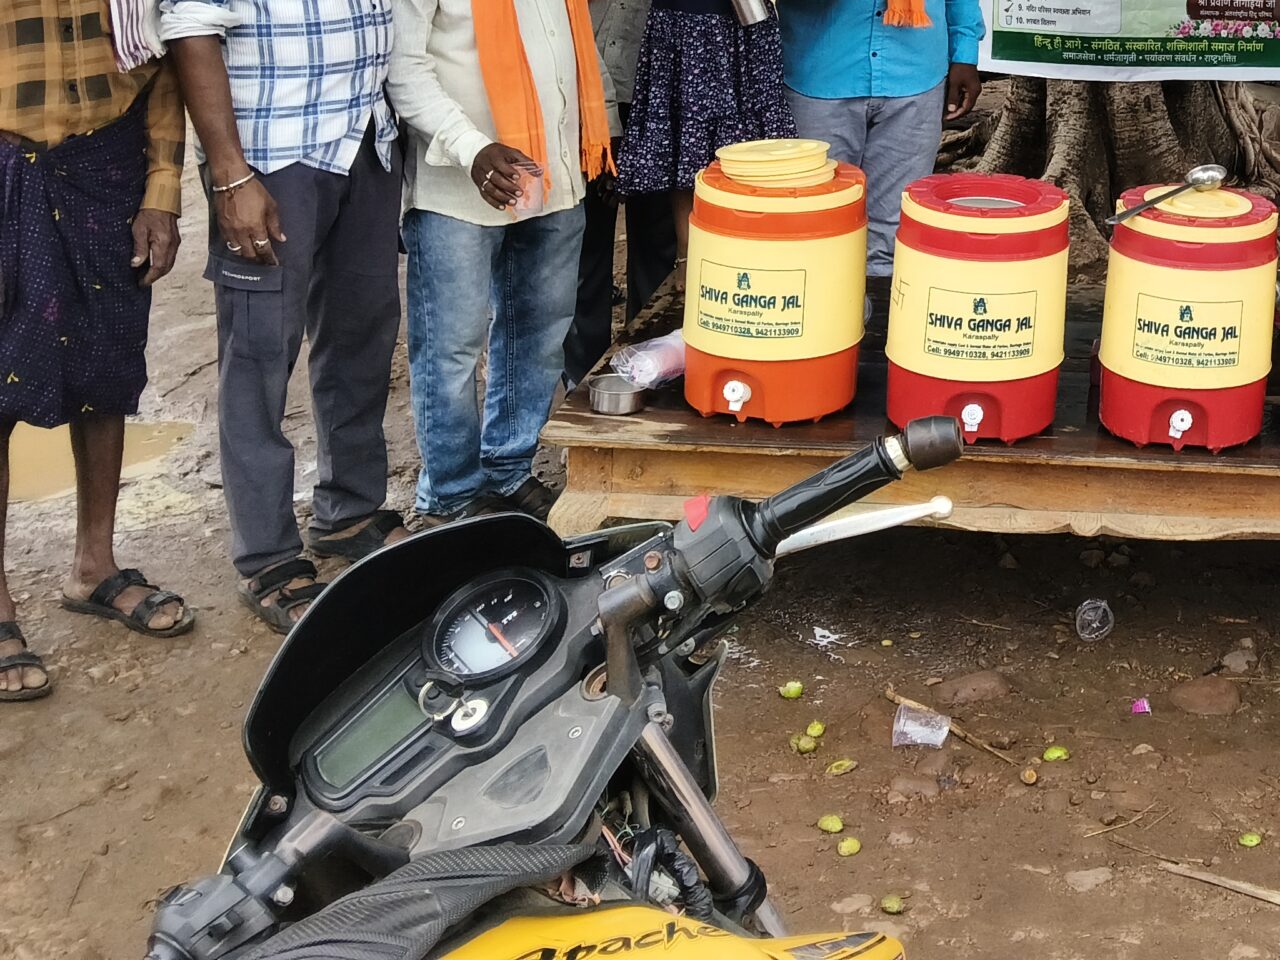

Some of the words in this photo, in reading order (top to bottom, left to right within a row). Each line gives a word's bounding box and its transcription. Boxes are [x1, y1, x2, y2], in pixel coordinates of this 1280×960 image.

[1034, 35, 1052, 49] हिन्दू
[1054, 36, 1061, 49] ही
[1064, 38, 1081, 49] आगे
[1091, 39, 1122, 52] संगठित,
[1125, 40, 1164, 52] संस्कारित,
[1211, 42, 1235, 51] समाज
[1238, 40, 1264, 52] निर्माण
[1062, 51, 1096, 61] समाजसेवा
[700, 285, 728, 304] SHIVA
[732, 293, 776, 310] GANGA
[781, 295, 801, 312] JAL
[700, 318, 710, 327] Cell:
[712, 322, 753, 336] 9949710328,
[928, 312, 963, 330] SHIVA
[968, 318, 1011, 332] GANGA
[1015, 316, 1032, 334] JAL
[1137, 318, 1169, 337] SHIVA
[1174, 326, 1217, 340] GANGA
[1221, 326, 1238, 342] JAL
[927, 345, 942, 354] Cell:
[944, 348, 988, 359] 9949710328,
[1136, 350, 1148, 358] Cell:
[515, 921, 732, 960] Apache
